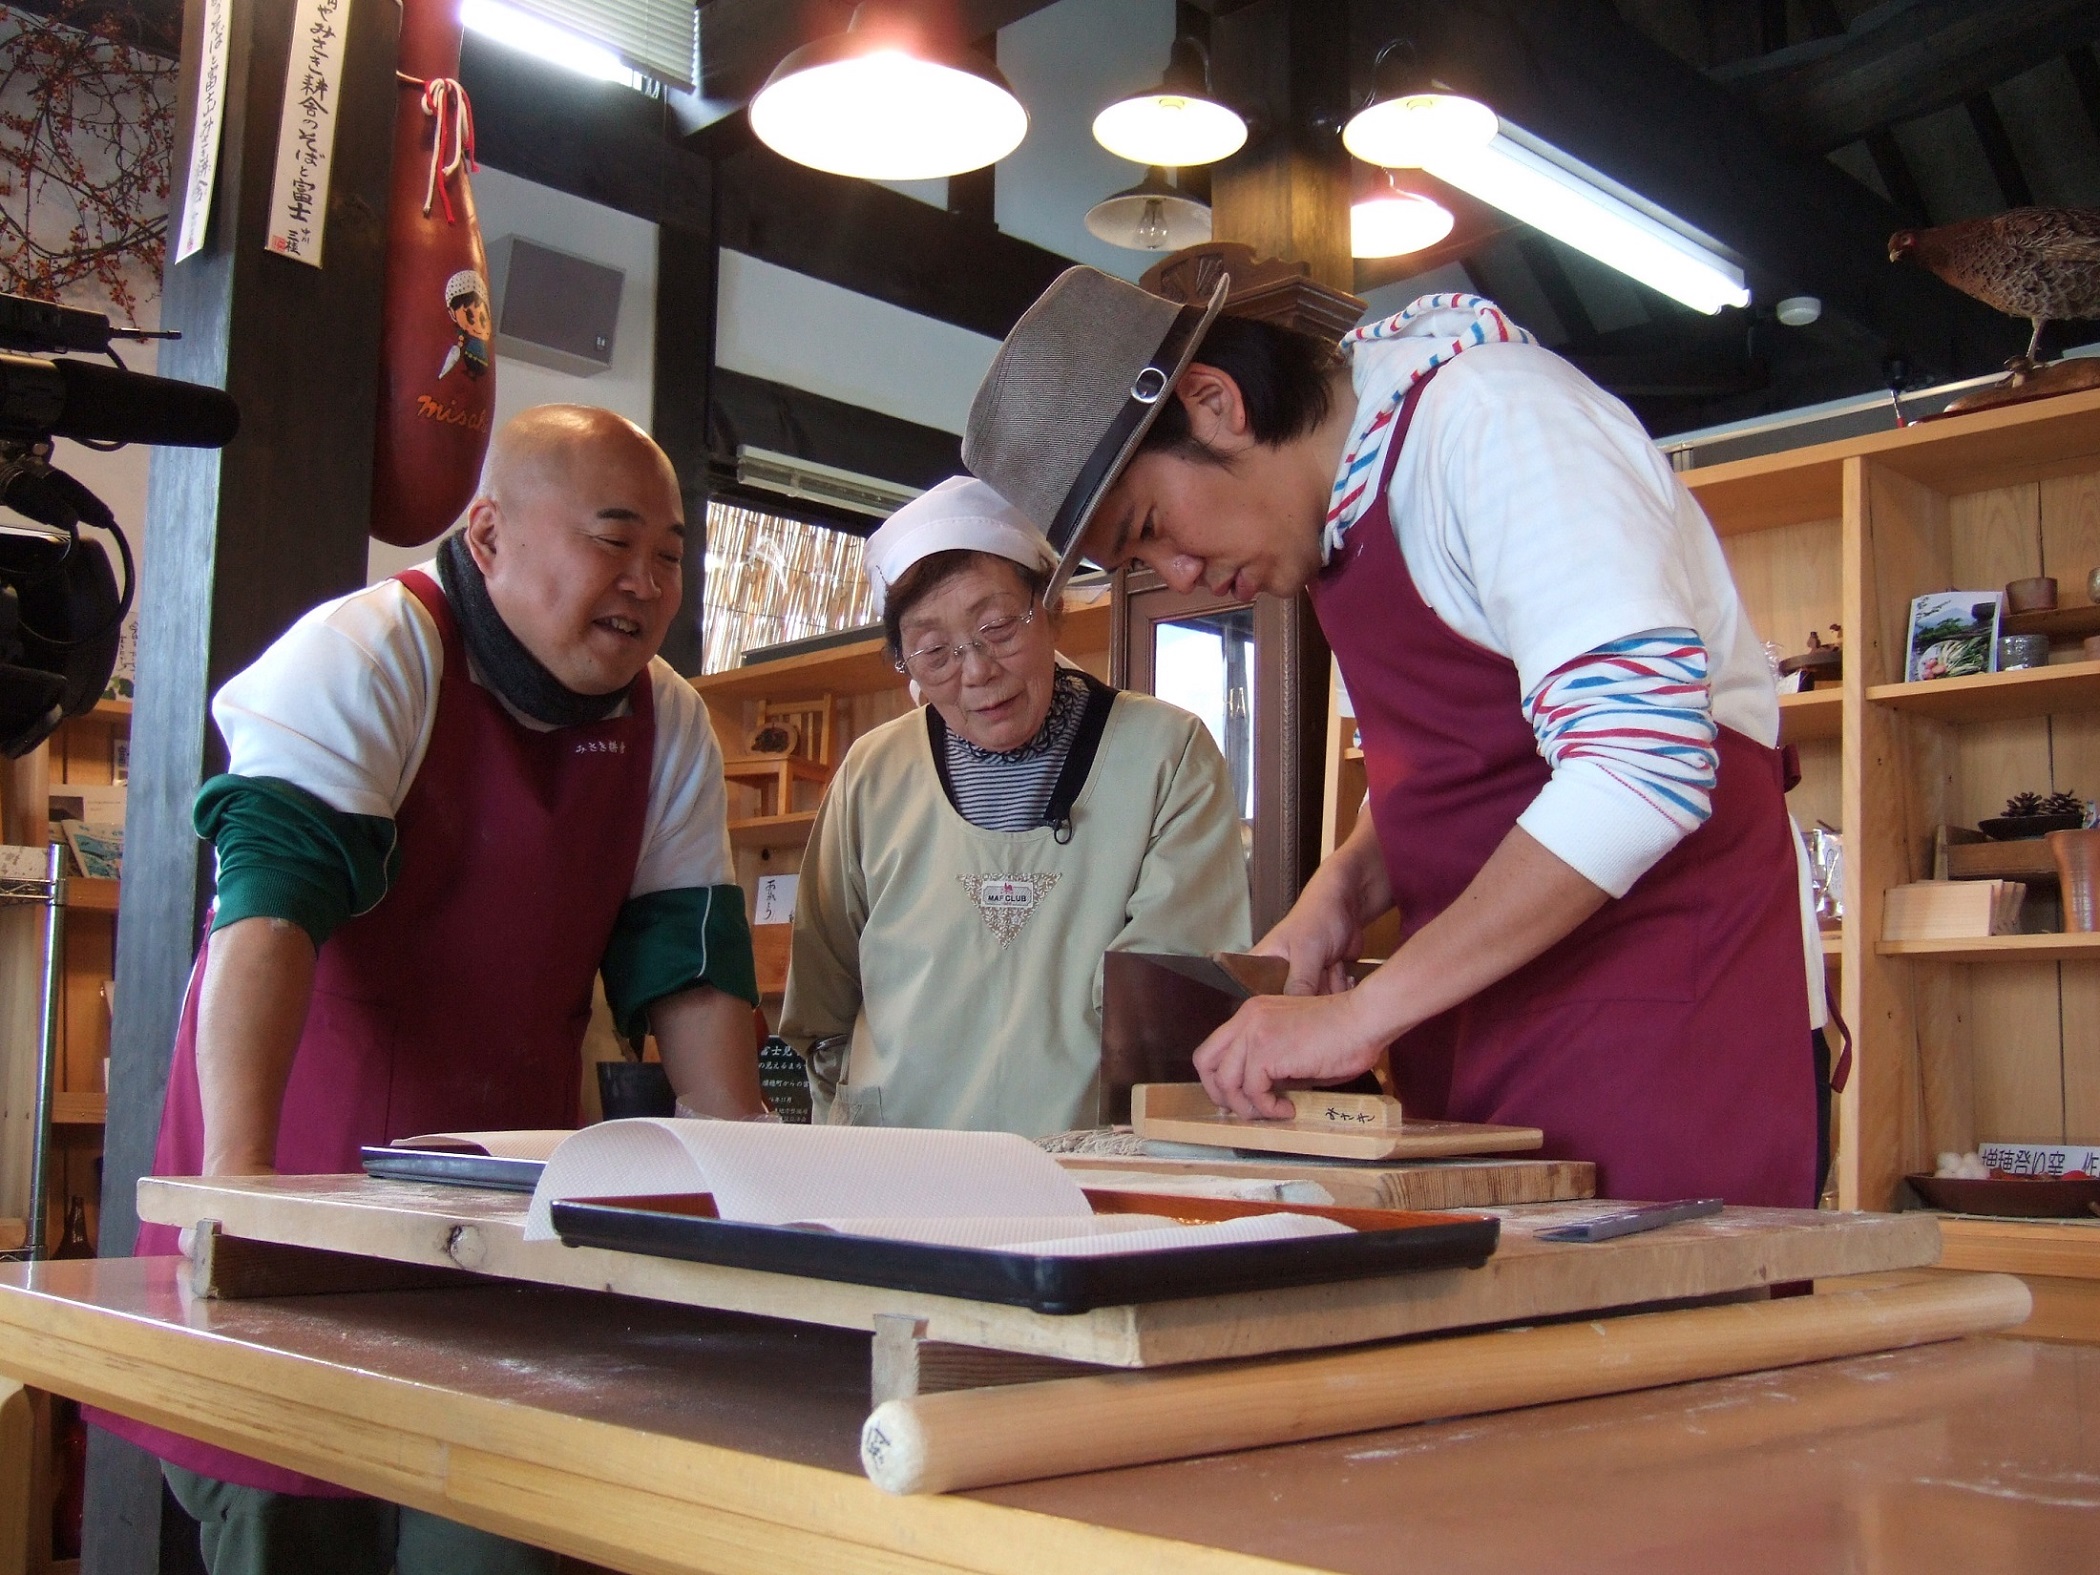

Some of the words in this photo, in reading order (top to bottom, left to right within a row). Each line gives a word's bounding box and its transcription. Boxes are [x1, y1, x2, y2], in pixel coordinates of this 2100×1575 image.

[759, 1061, 807, 1070] の見えるまち
[1325, 1107, 1376, 1124] みさき
